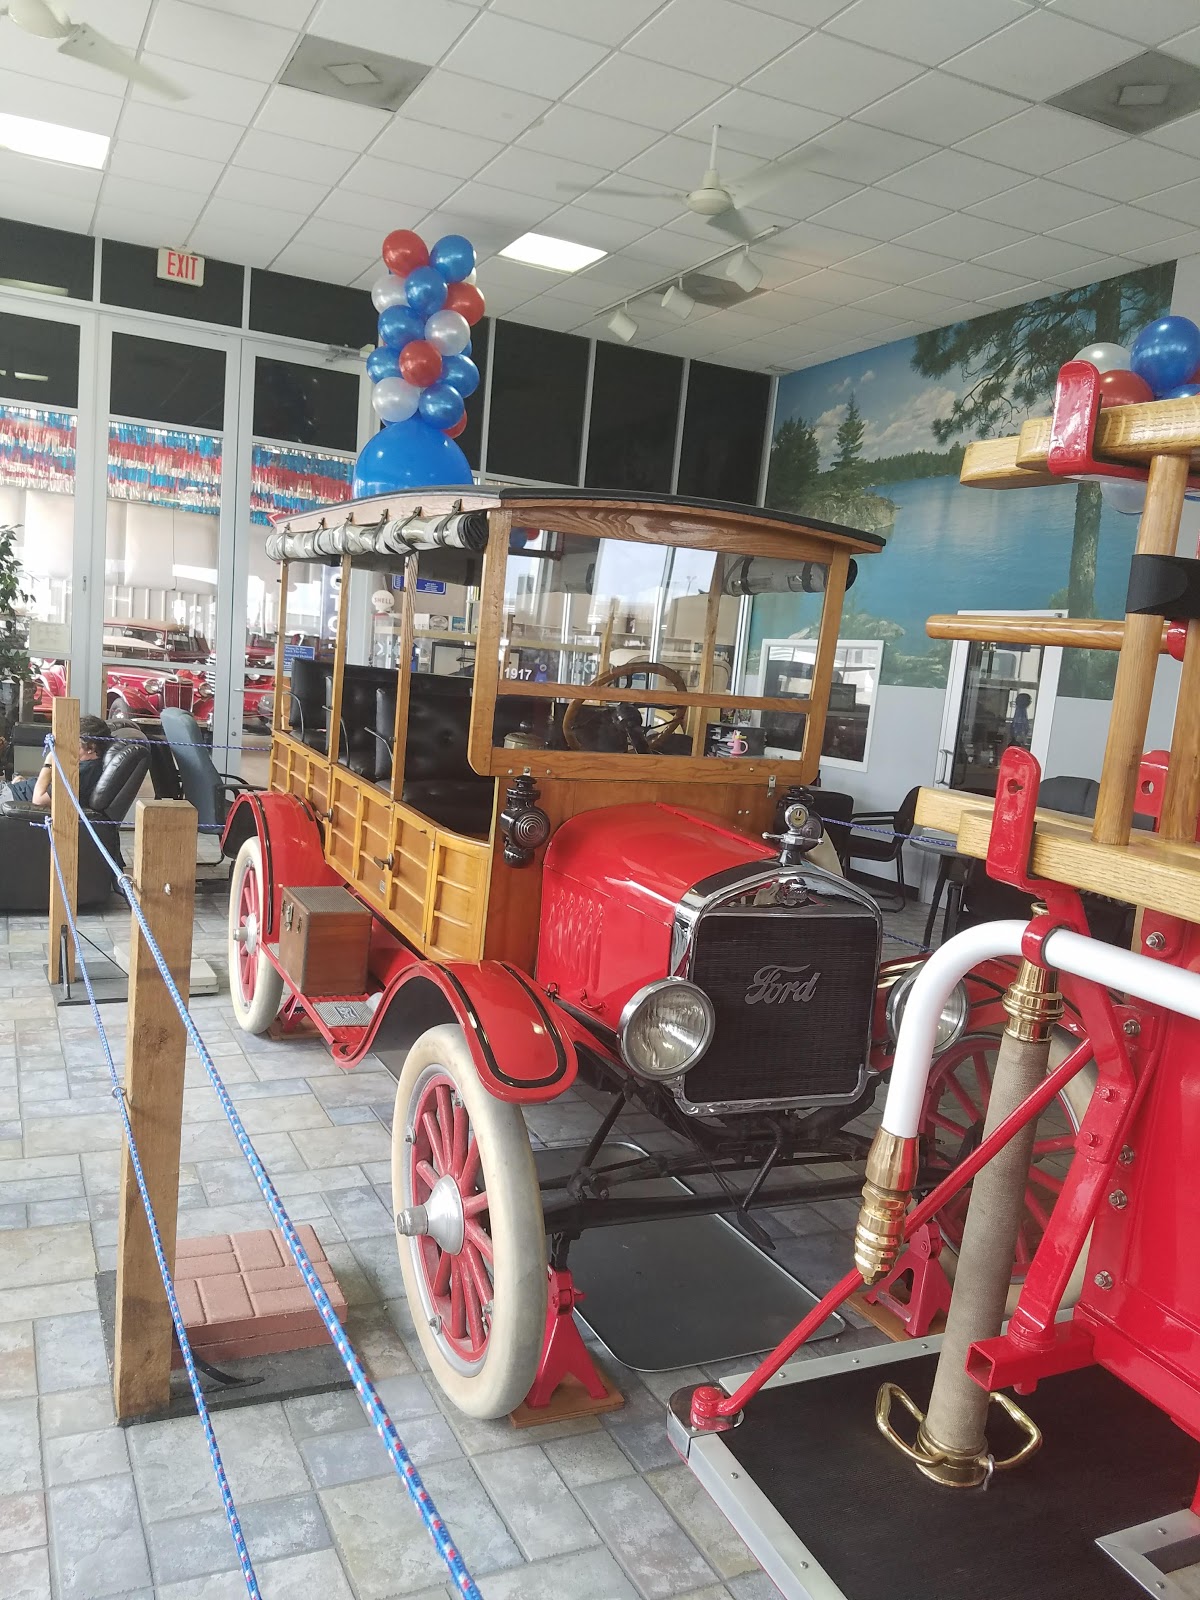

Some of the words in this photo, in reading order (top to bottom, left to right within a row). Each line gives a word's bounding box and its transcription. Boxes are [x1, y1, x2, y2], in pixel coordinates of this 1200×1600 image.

[167, 251, 198, 280] EXIT
[373, 597, 393, 605] SHELL
[504, 667, 533, 681] 1917
[744, 963, 822, 1005] Ford
